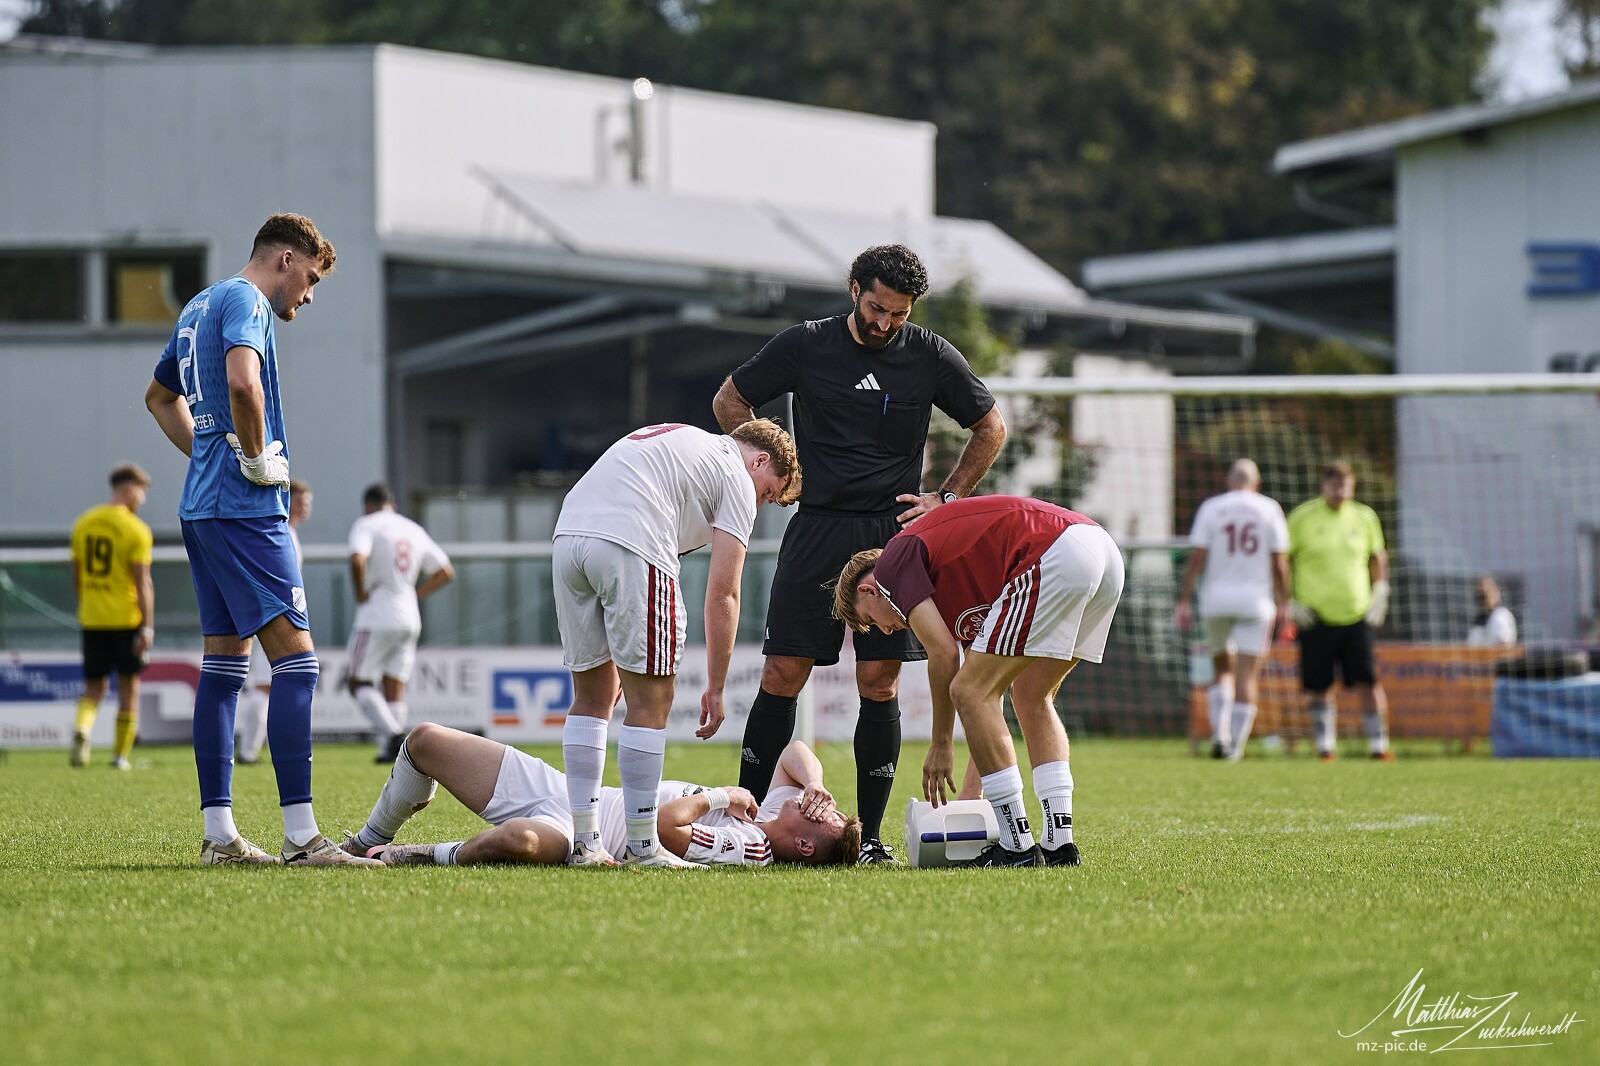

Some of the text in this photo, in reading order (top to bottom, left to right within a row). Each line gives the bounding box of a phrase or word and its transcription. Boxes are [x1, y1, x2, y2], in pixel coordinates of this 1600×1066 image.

[177, 321, 203, 407] 21
[86, 534, 114, 578] 19
[394, 538, 413, 574] 8
[1223, 521, 1259, 557] 16
